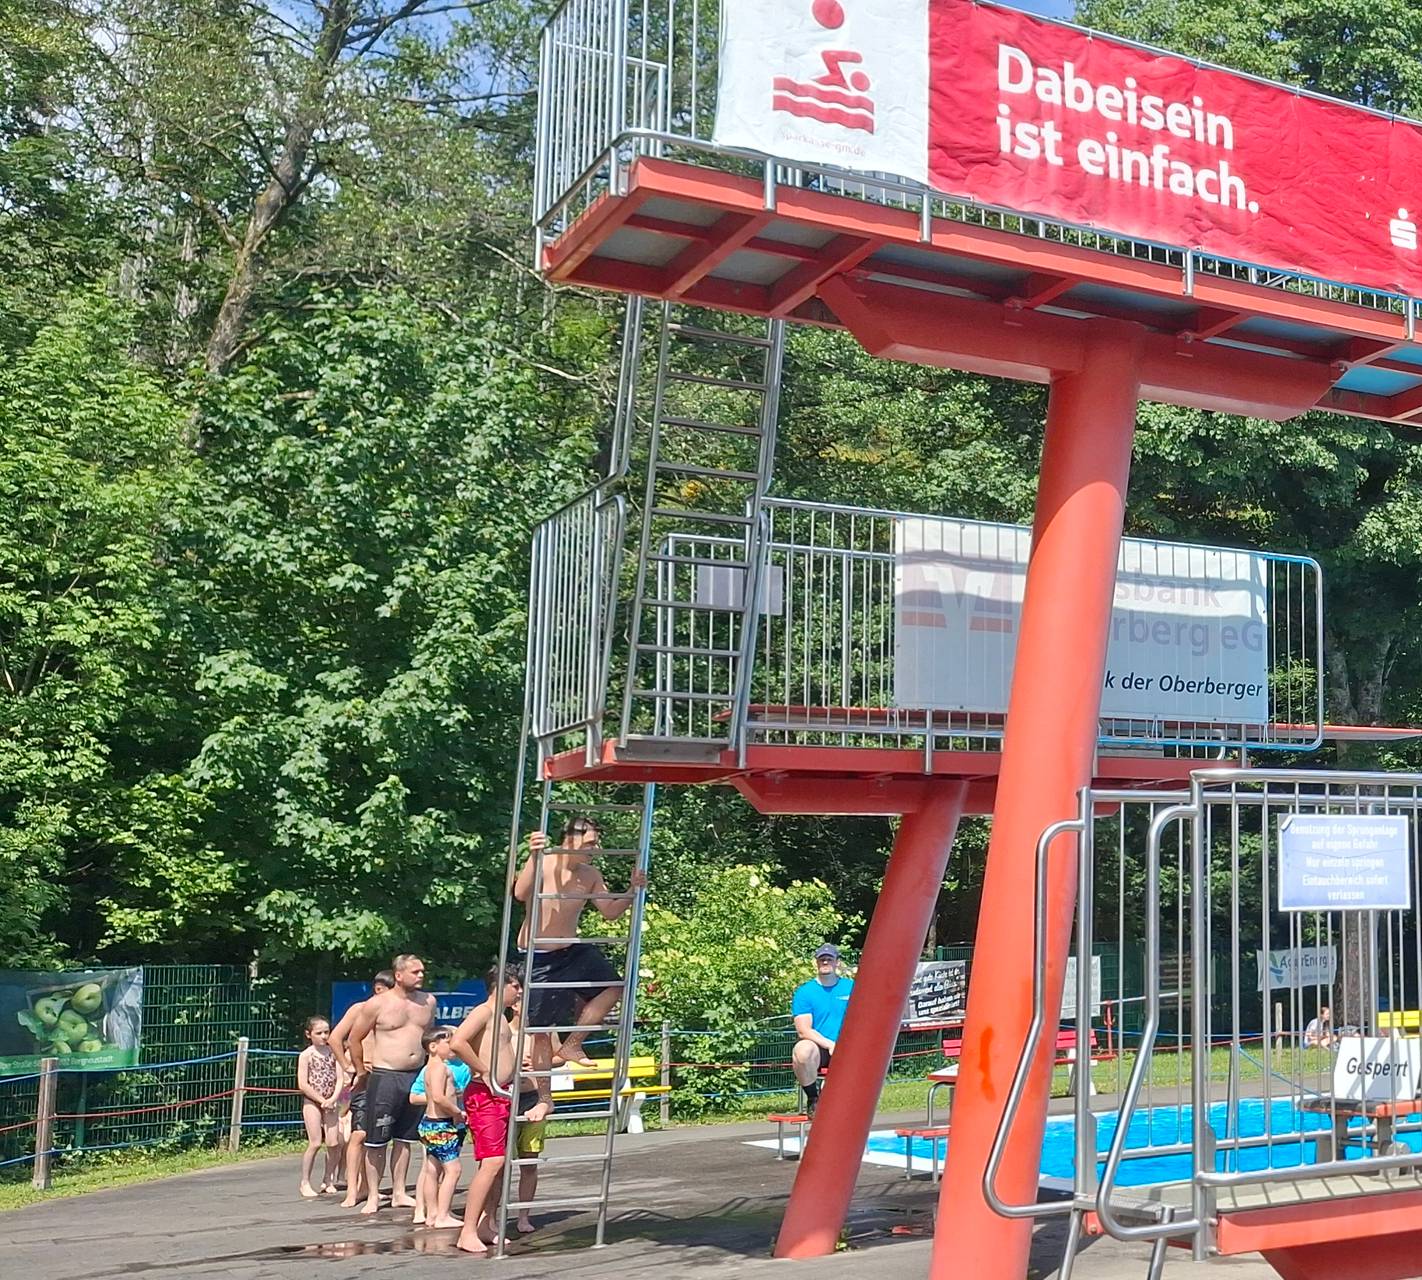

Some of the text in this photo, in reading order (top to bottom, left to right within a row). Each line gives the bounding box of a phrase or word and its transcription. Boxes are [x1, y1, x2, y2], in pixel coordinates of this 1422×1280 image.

[998, 43, 1233, 150] Dabeisein
[996, 103, 1260, 213] ist einfach.
[1113, 610, 1264, 657] rberg eG
[1121, 672, 1153, 691] der
[1159, 674, 1263, 700] Oberberger
[1280, 952, 1334, 970] AggrEnrge
[1346, 1057, 1409, 1080] Gespert
